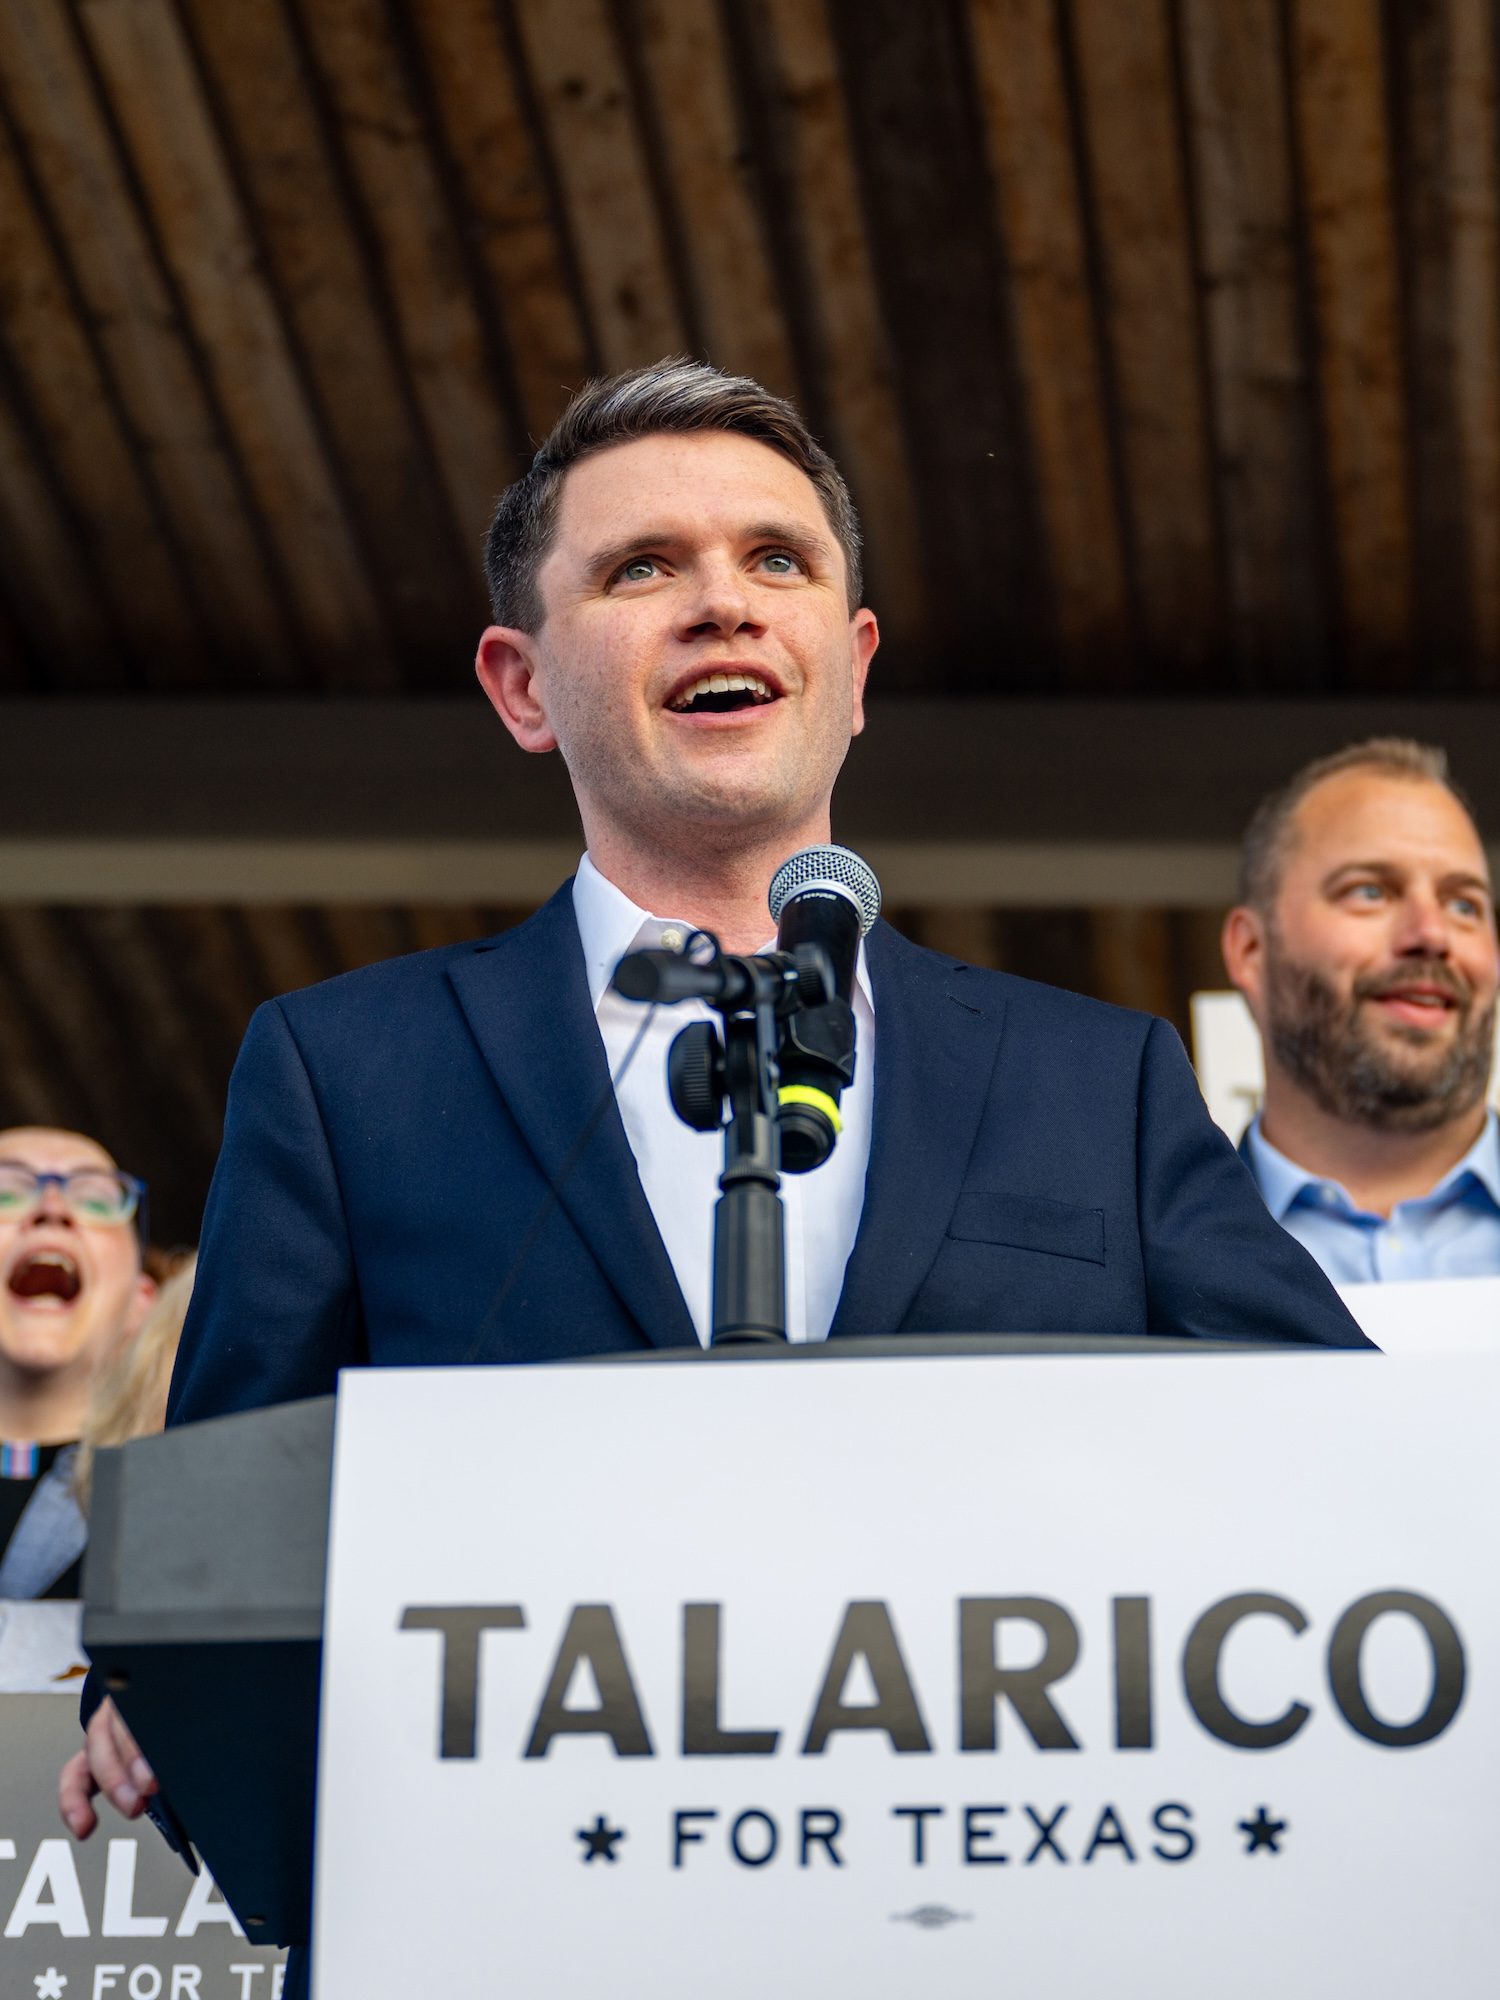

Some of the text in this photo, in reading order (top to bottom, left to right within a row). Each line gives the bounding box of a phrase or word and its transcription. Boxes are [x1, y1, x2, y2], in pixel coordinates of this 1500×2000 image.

[398, 1589, 1469, 1762] TALARICO
[672, 1801, 1198, 1870] FOR TEXAS
[0, 1838, 247, 1938] ALA
[92, 1963, 203, 2000] FOR
